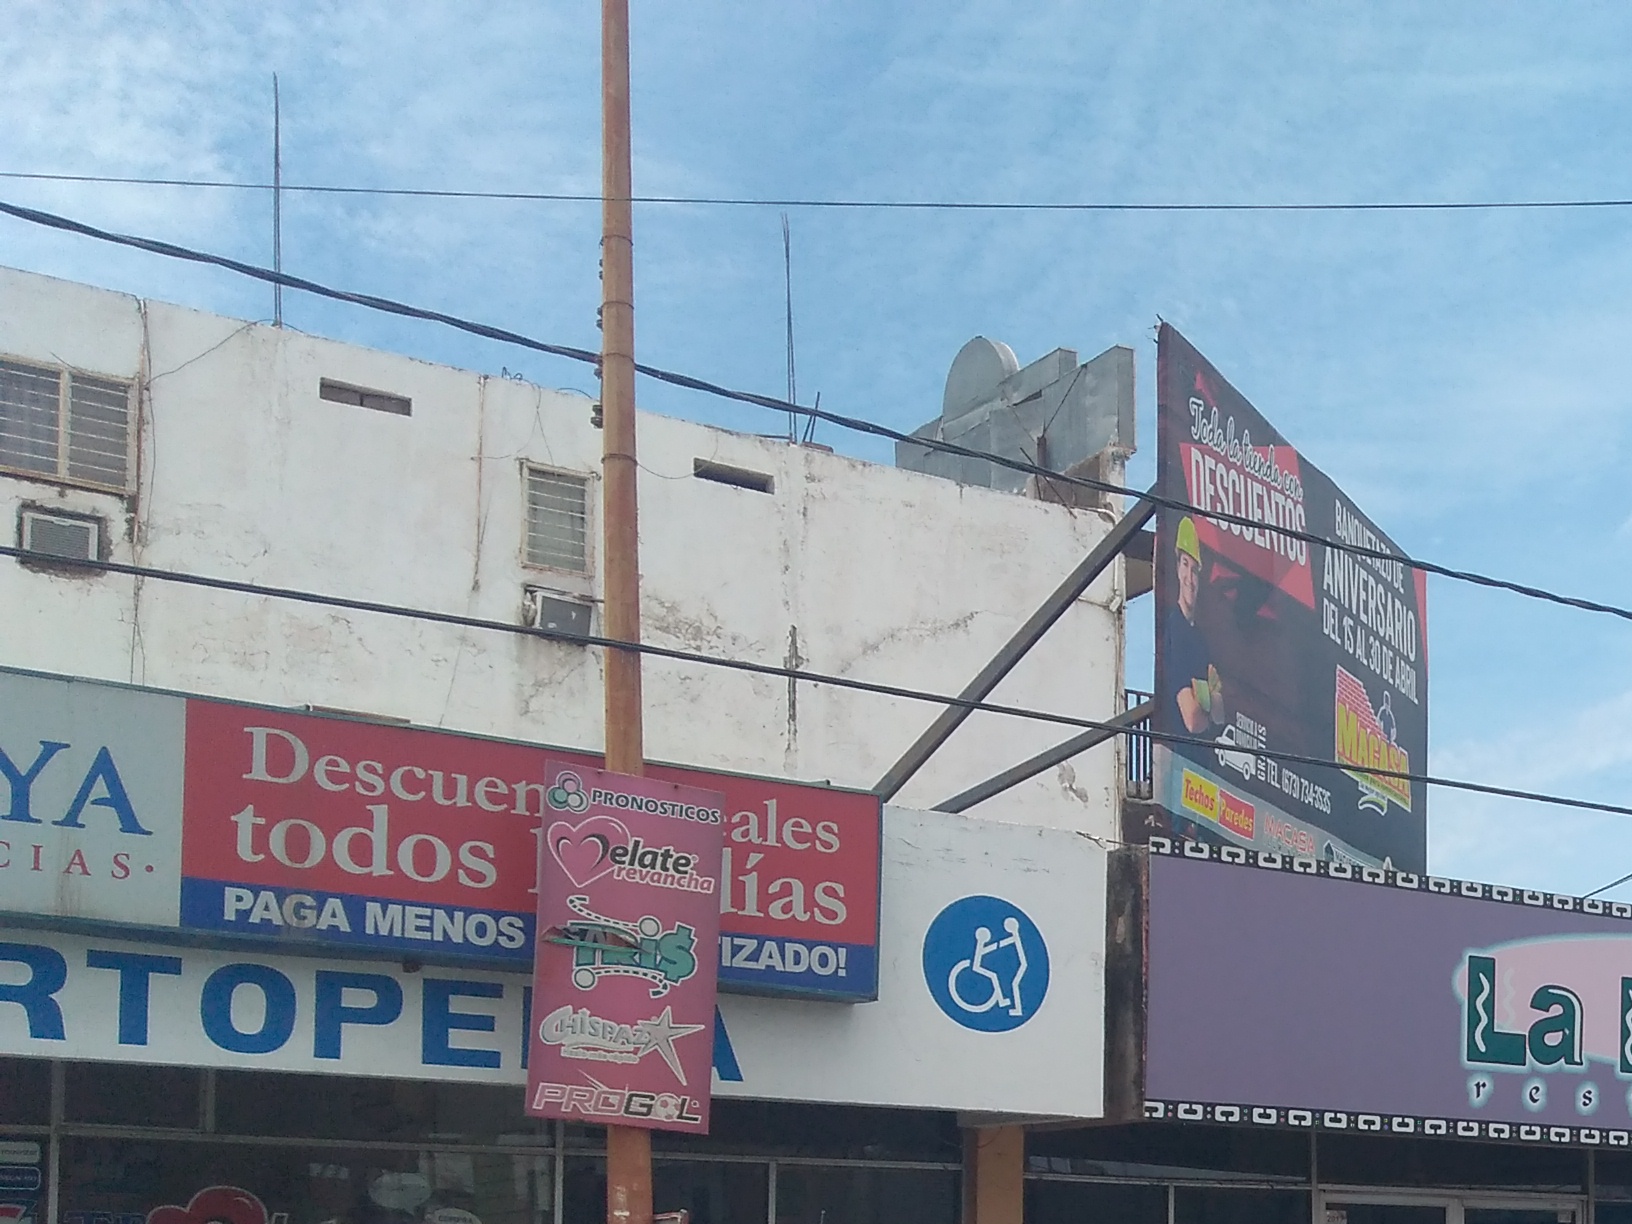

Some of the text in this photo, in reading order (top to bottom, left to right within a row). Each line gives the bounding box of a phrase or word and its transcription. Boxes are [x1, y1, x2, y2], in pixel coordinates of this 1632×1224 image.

[1191, 447, 1306, 566] DESCUENTOS
[1323, 538, 1416, 663] ANIVERSARIO
[1323, 598, 1418, 705] DEL 15 AL 30 DE ABRIL
[0, 740, 153, 837] YA
[243, 726, 840, 853] Descuen ales
[1185, 778, 1215, 812] Techos
[1257, 724, 1267, 781] GRTIS
[1337, 703, 1409, 800] MACASA
[231, 804, 497, 888] todos
[591, 789, 721, 825] PRONOSTICOS
[1220, 798, 1253, 832] Paredes
[611, 864, 715, 894] revancha
[224, 886, 847, 977] PAGA MENOS IZADO!
[1466, 954, 1583, 1068] La
